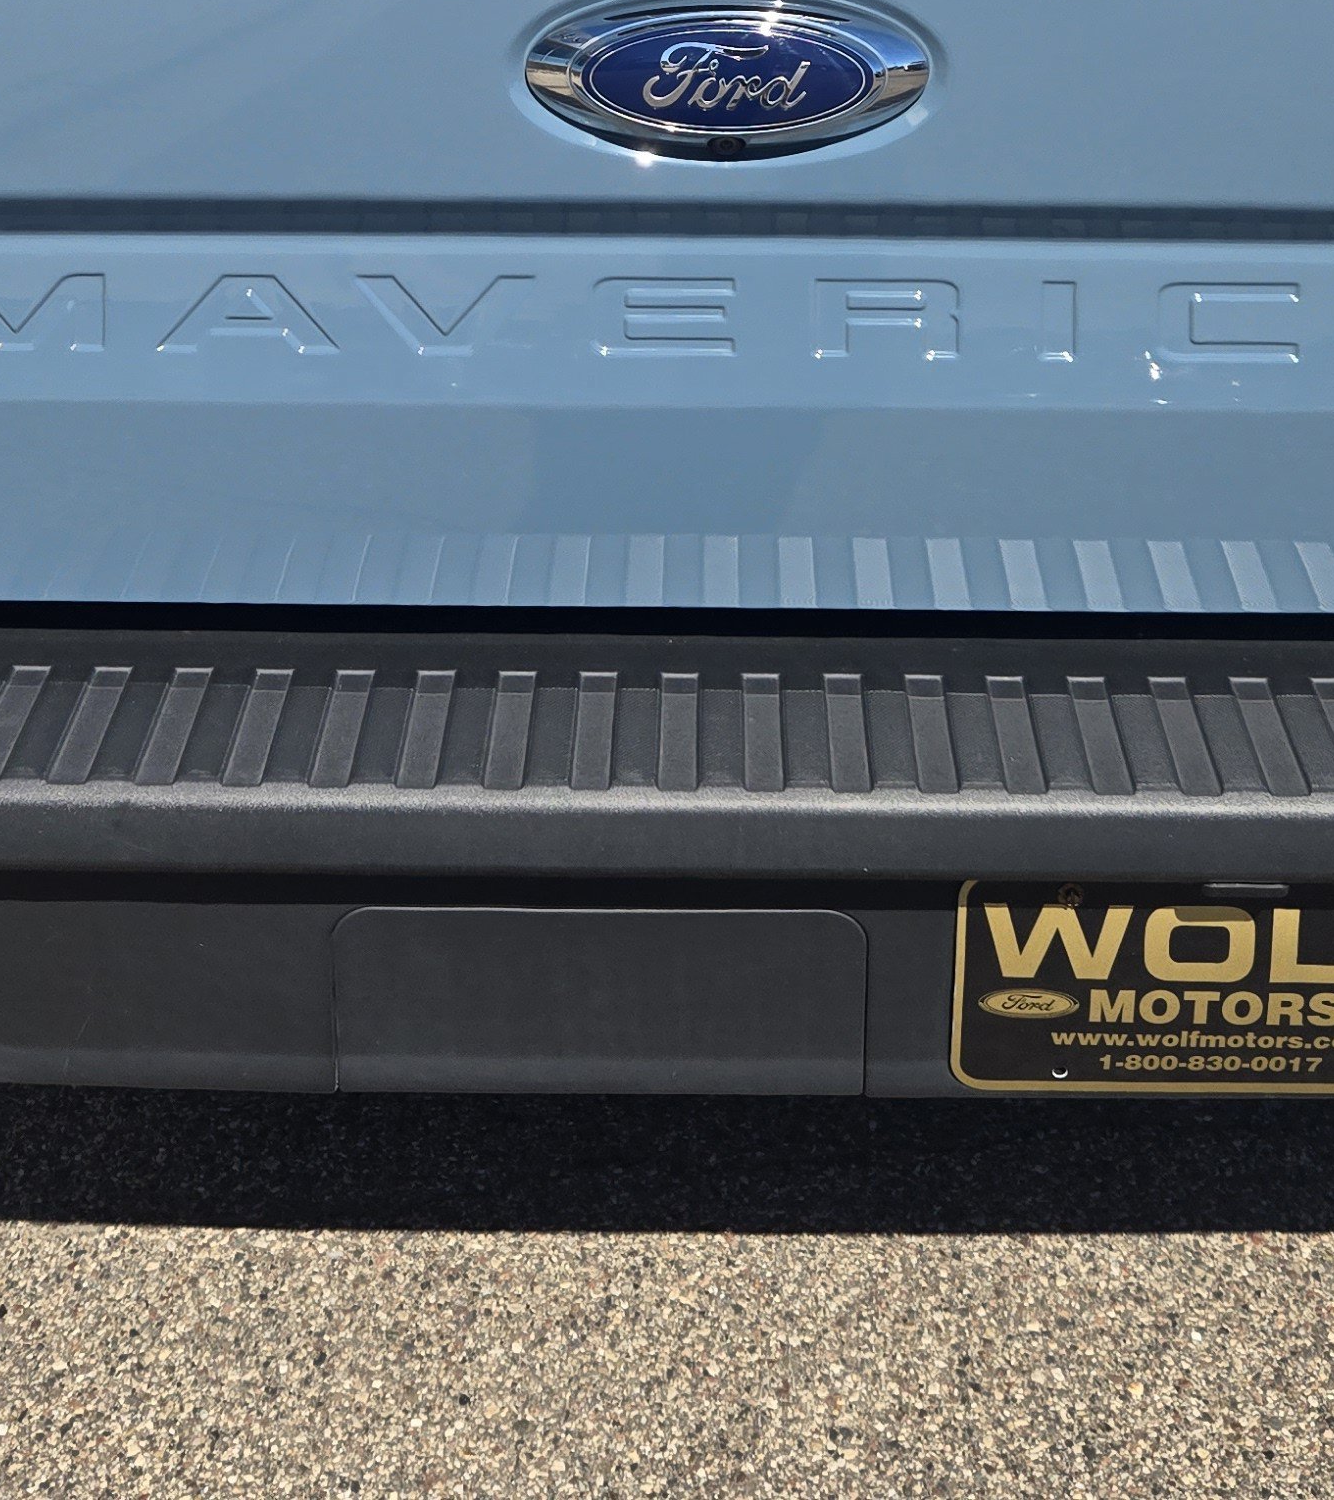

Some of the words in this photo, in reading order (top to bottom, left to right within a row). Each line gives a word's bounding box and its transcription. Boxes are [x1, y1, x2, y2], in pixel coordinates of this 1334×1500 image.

[641, 41, 811, 111] Ford
[1002, 994, 1056, 1012] Ford
[1099, 1054, 1323, 1073] 1-800-830-0017
